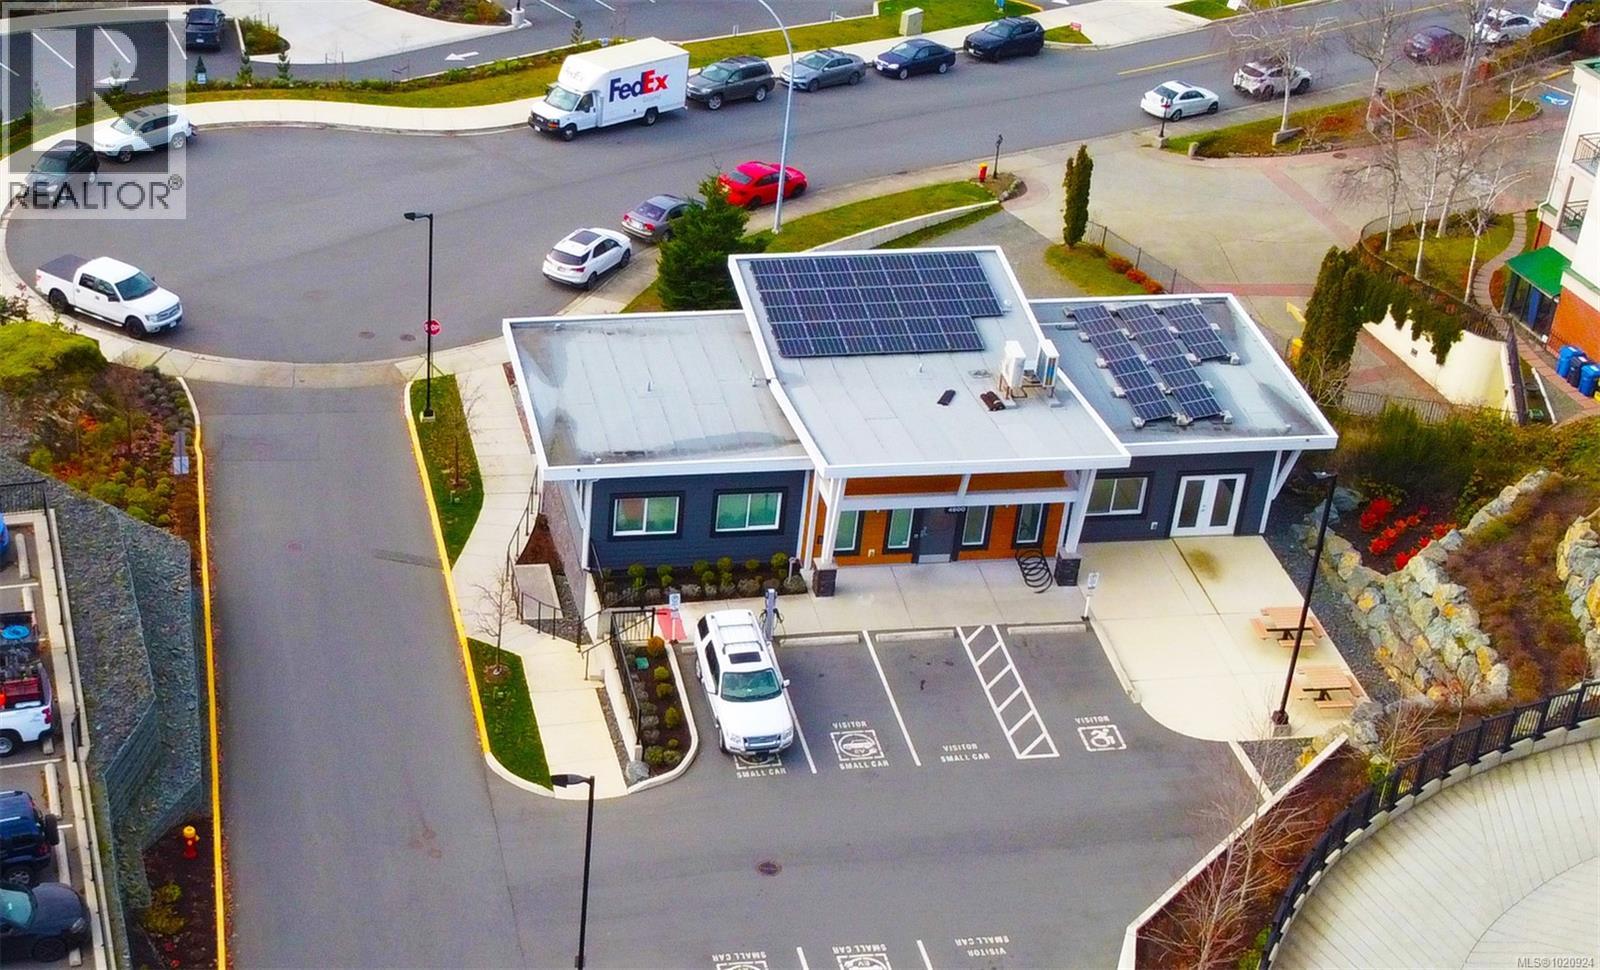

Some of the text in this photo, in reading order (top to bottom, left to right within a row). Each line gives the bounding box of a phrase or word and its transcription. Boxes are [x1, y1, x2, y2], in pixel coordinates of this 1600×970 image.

[609, 69, 669, 102] FedEx
[832, 720, 868, 730] VISITOR
[1074, 715, 1111, 724] VISITOR
[942, 743, 978, 752] VISITOR
[940, 753, 991, 763] SMALL CAR
[838, 759, 890, 770] SMALL CAR
[736, 767, 787, 779] SMALL CAR
[954, 935, 1010, 947] SMALL CAR
[832, 943, 887, 954] SMALL CAR
[967, 947, 1007, 957] VISITOR
[712, 951, 767, 962] SMALL CAR
